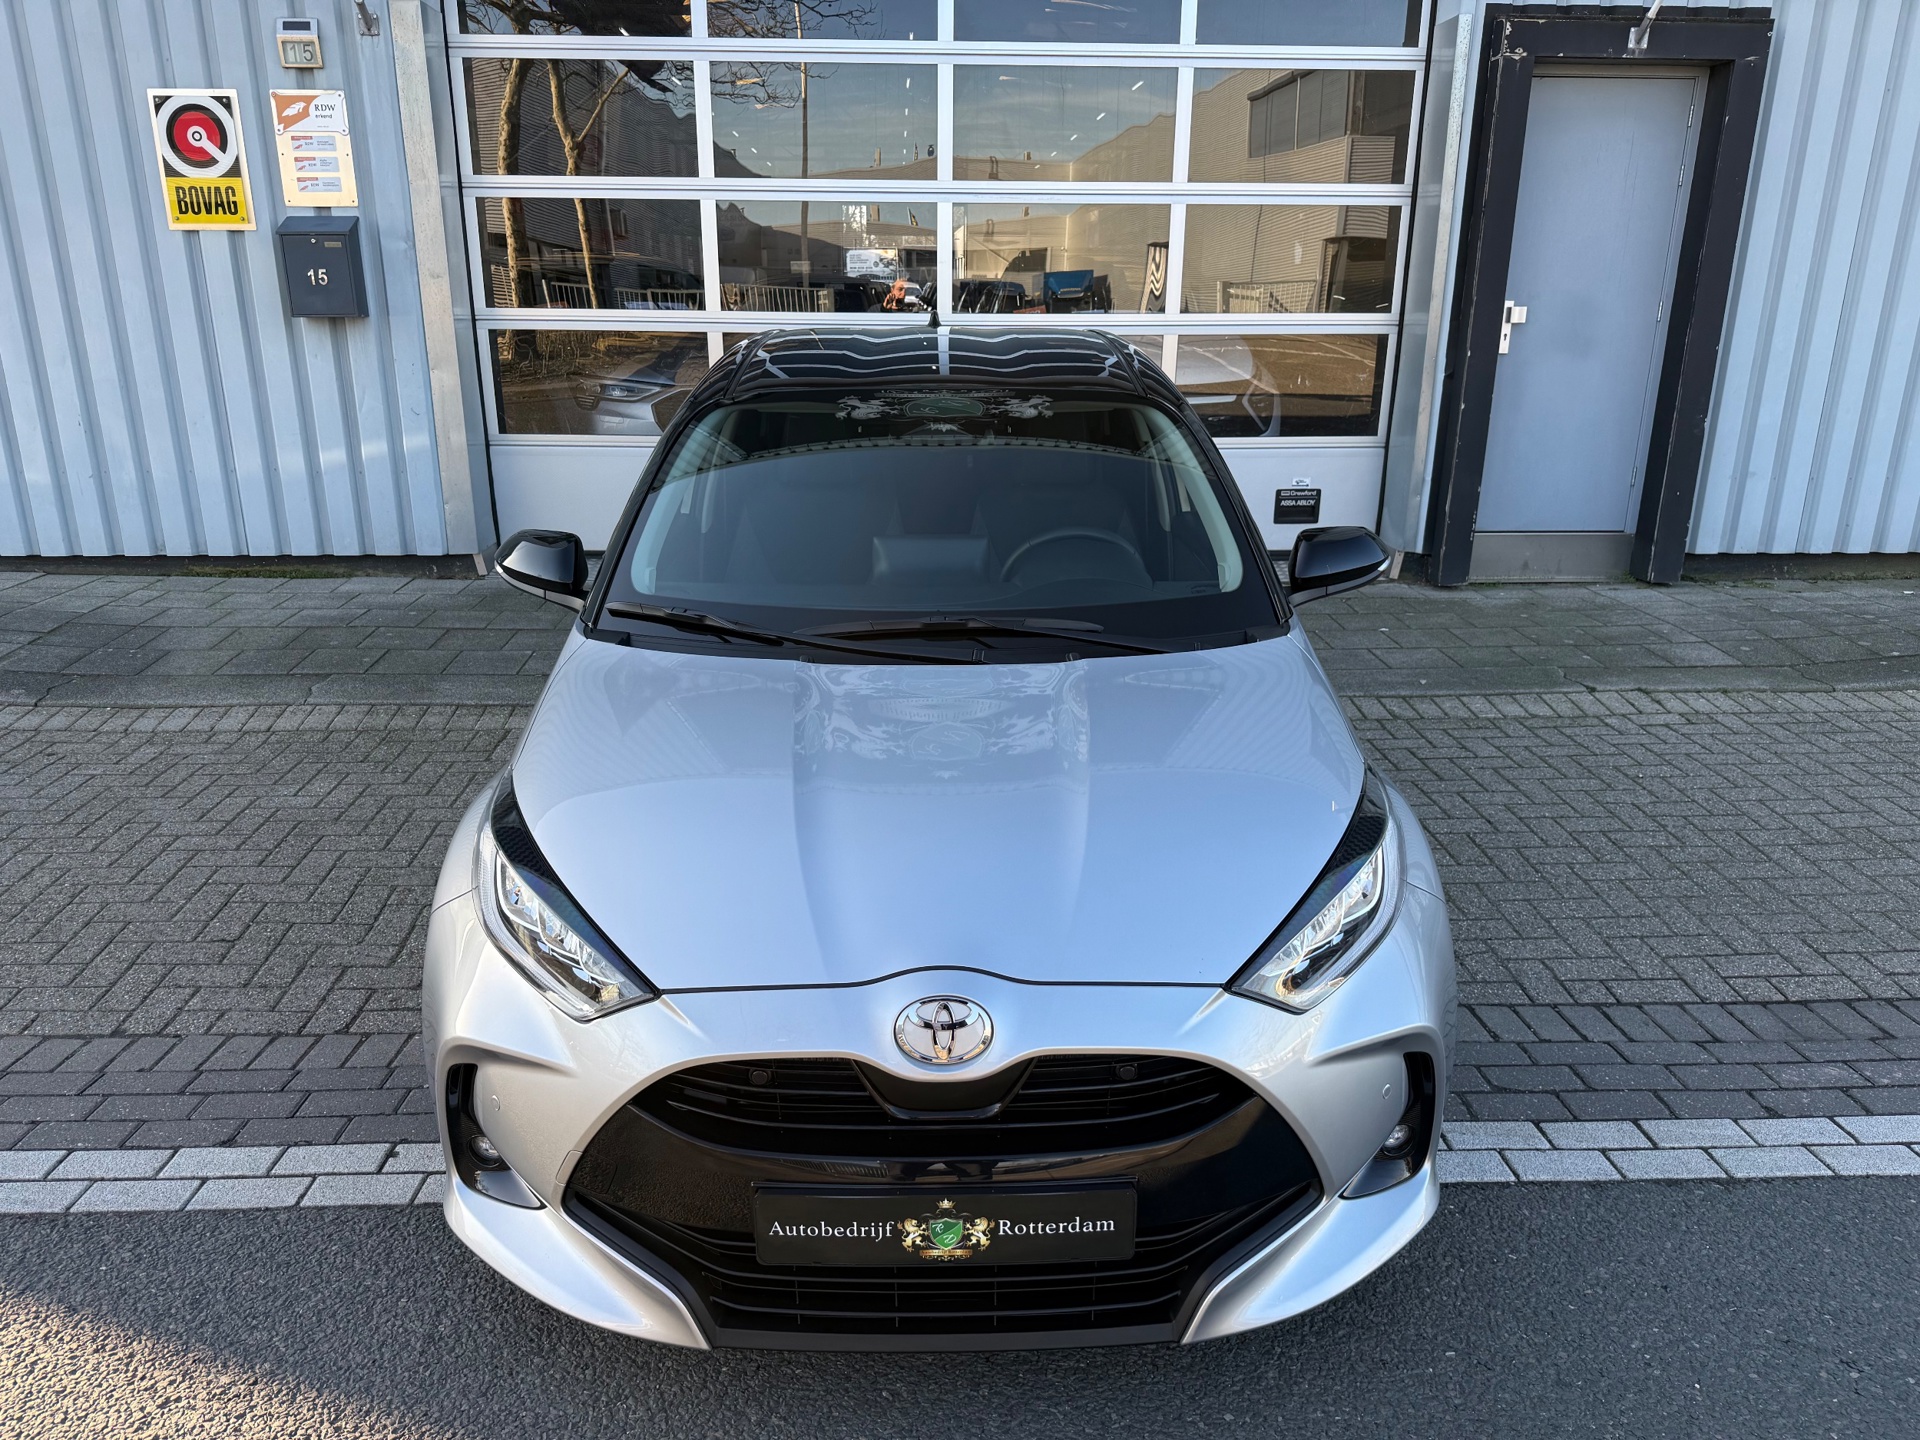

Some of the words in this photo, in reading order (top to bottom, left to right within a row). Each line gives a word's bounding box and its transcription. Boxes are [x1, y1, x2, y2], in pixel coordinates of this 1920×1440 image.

[290, 43, 313, 62] 15
[314, 103, 336, 112] RDW
[175, 186, 238, 215] BOVAG
[307, 268, 328, 285] 15
[769, 1221, 894, 1242] Autobedrijf
[998, 1216, 1115, 1236] Rotterdam
